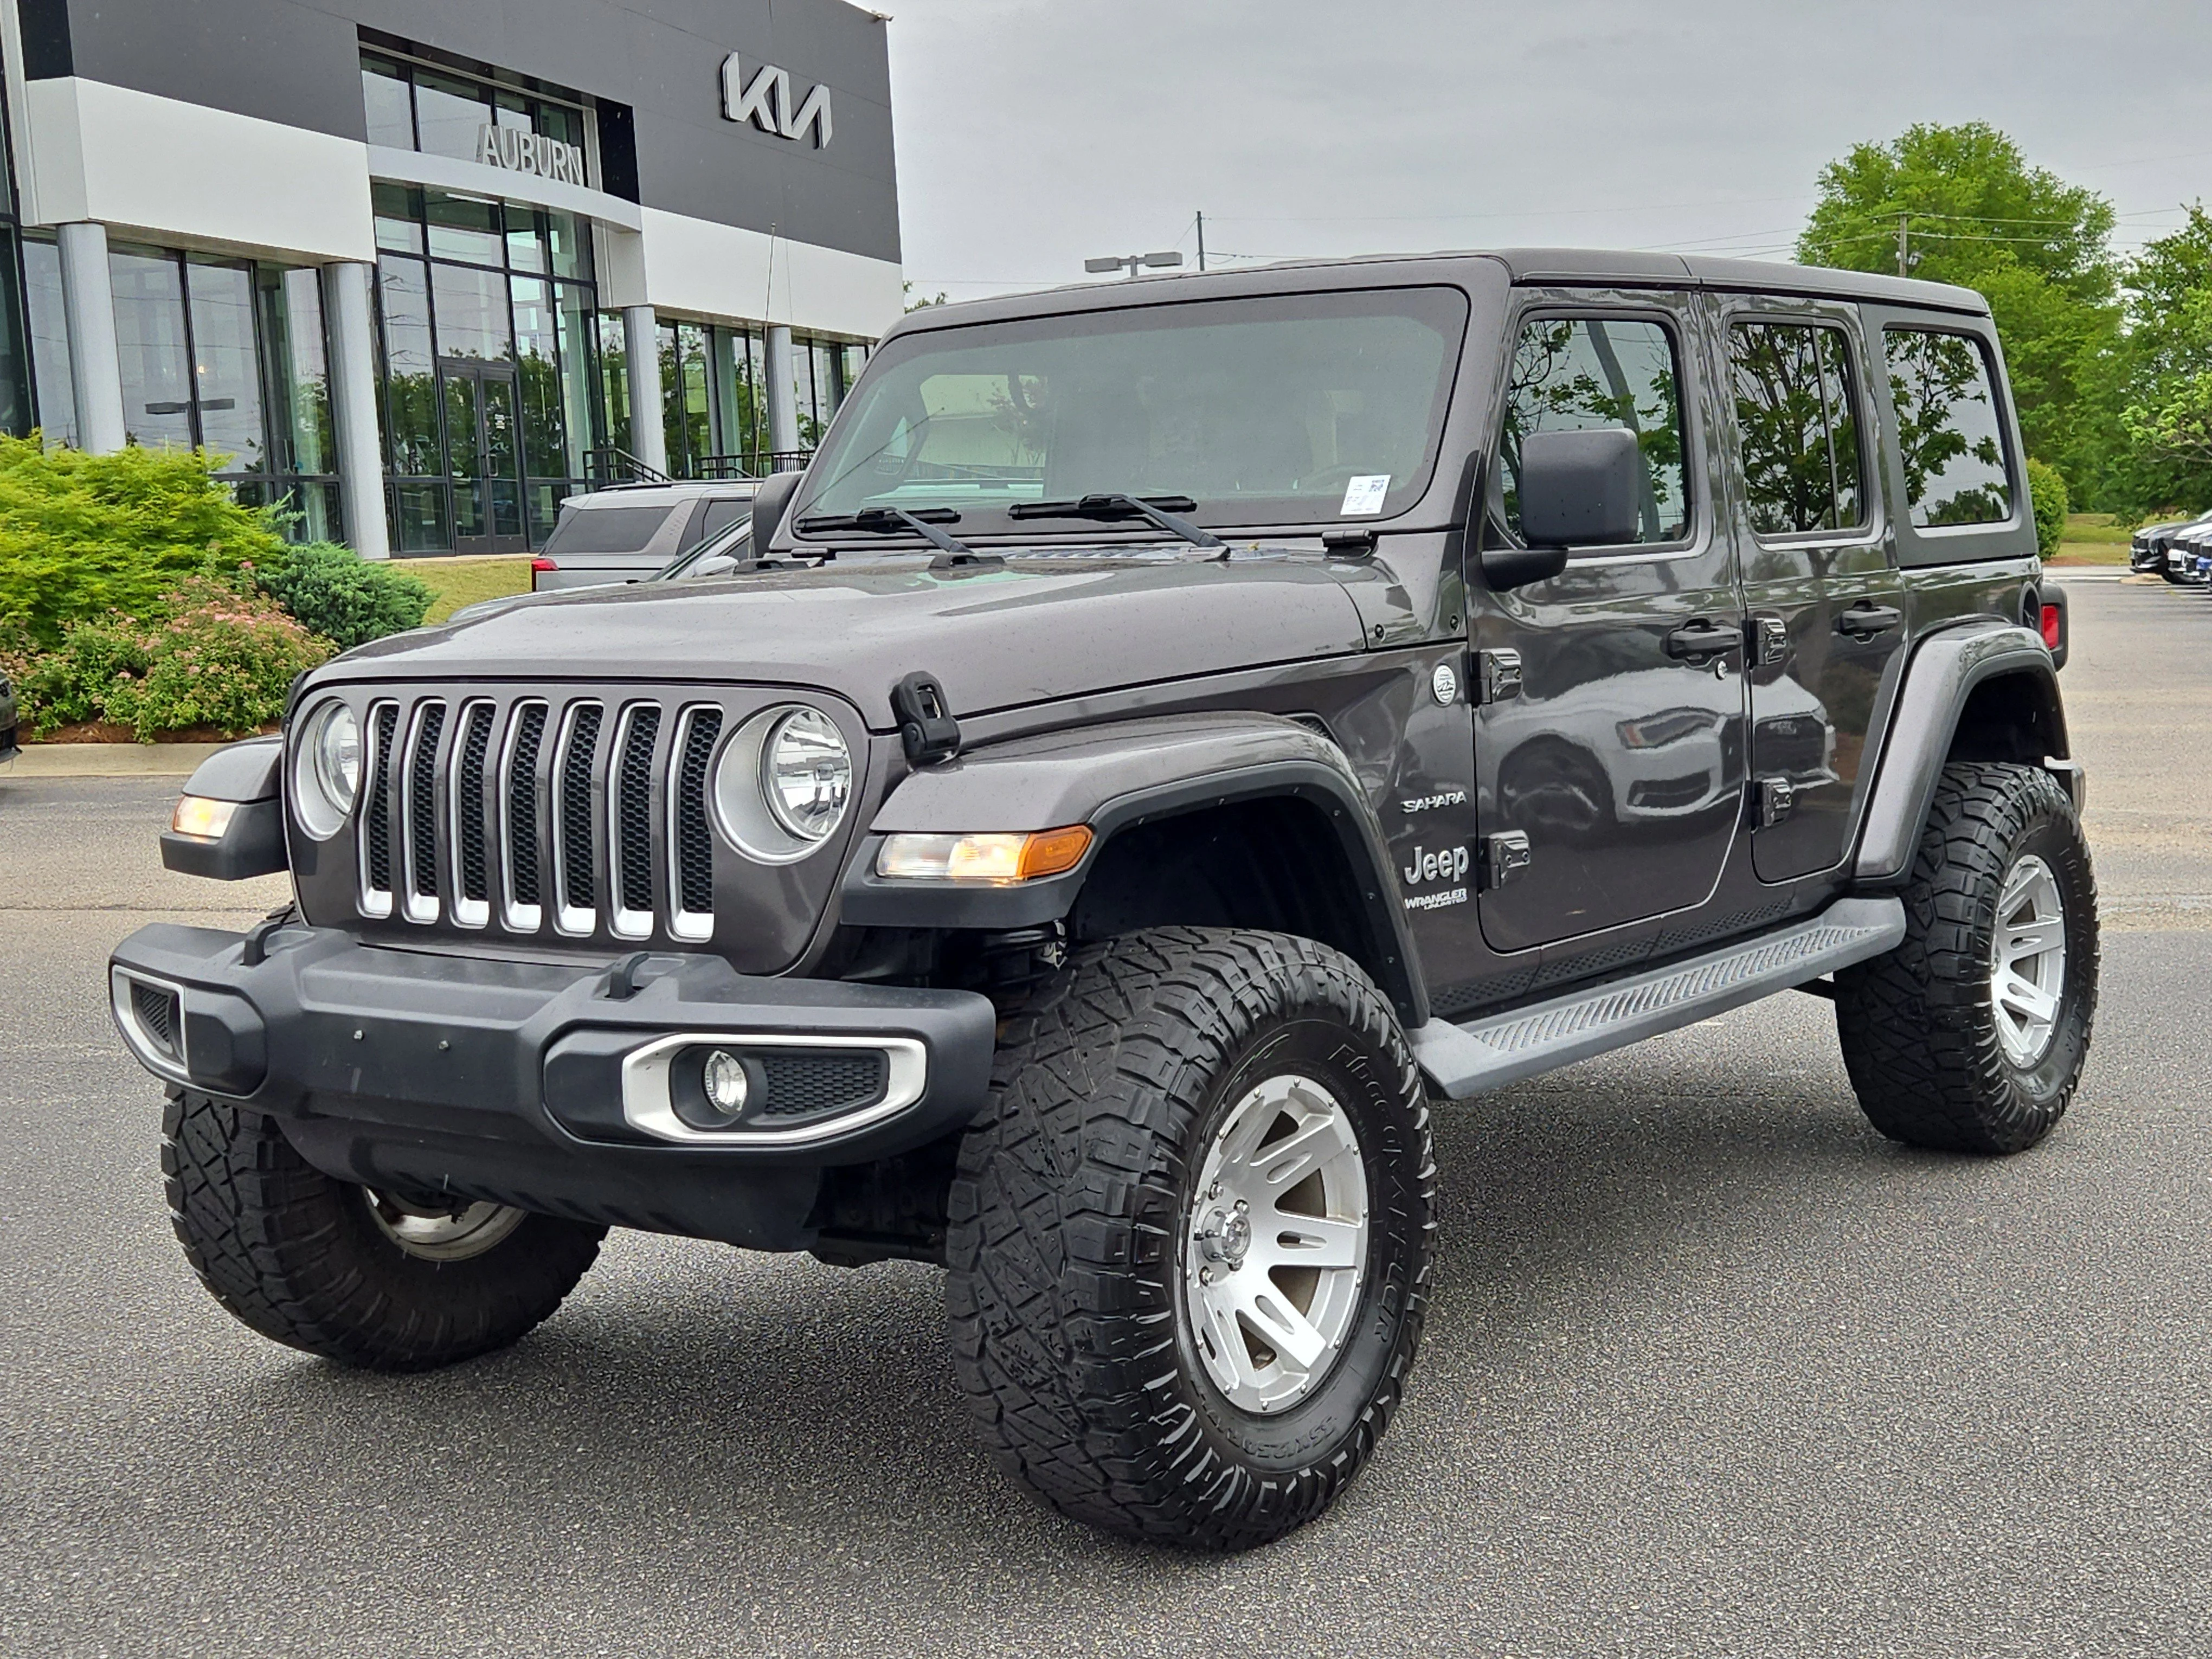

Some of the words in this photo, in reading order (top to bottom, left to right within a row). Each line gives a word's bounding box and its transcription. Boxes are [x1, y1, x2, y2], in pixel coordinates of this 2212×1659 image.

[477, 124, 583, 186] AUBURN
[1401, 791, 1467, 813] SAHARA
[1404, 846, 1469, 884] Jeep
[1404, 888, 1467, 909] WRANGLER
[1424, 897, 1467, 910] UNLIMITED
